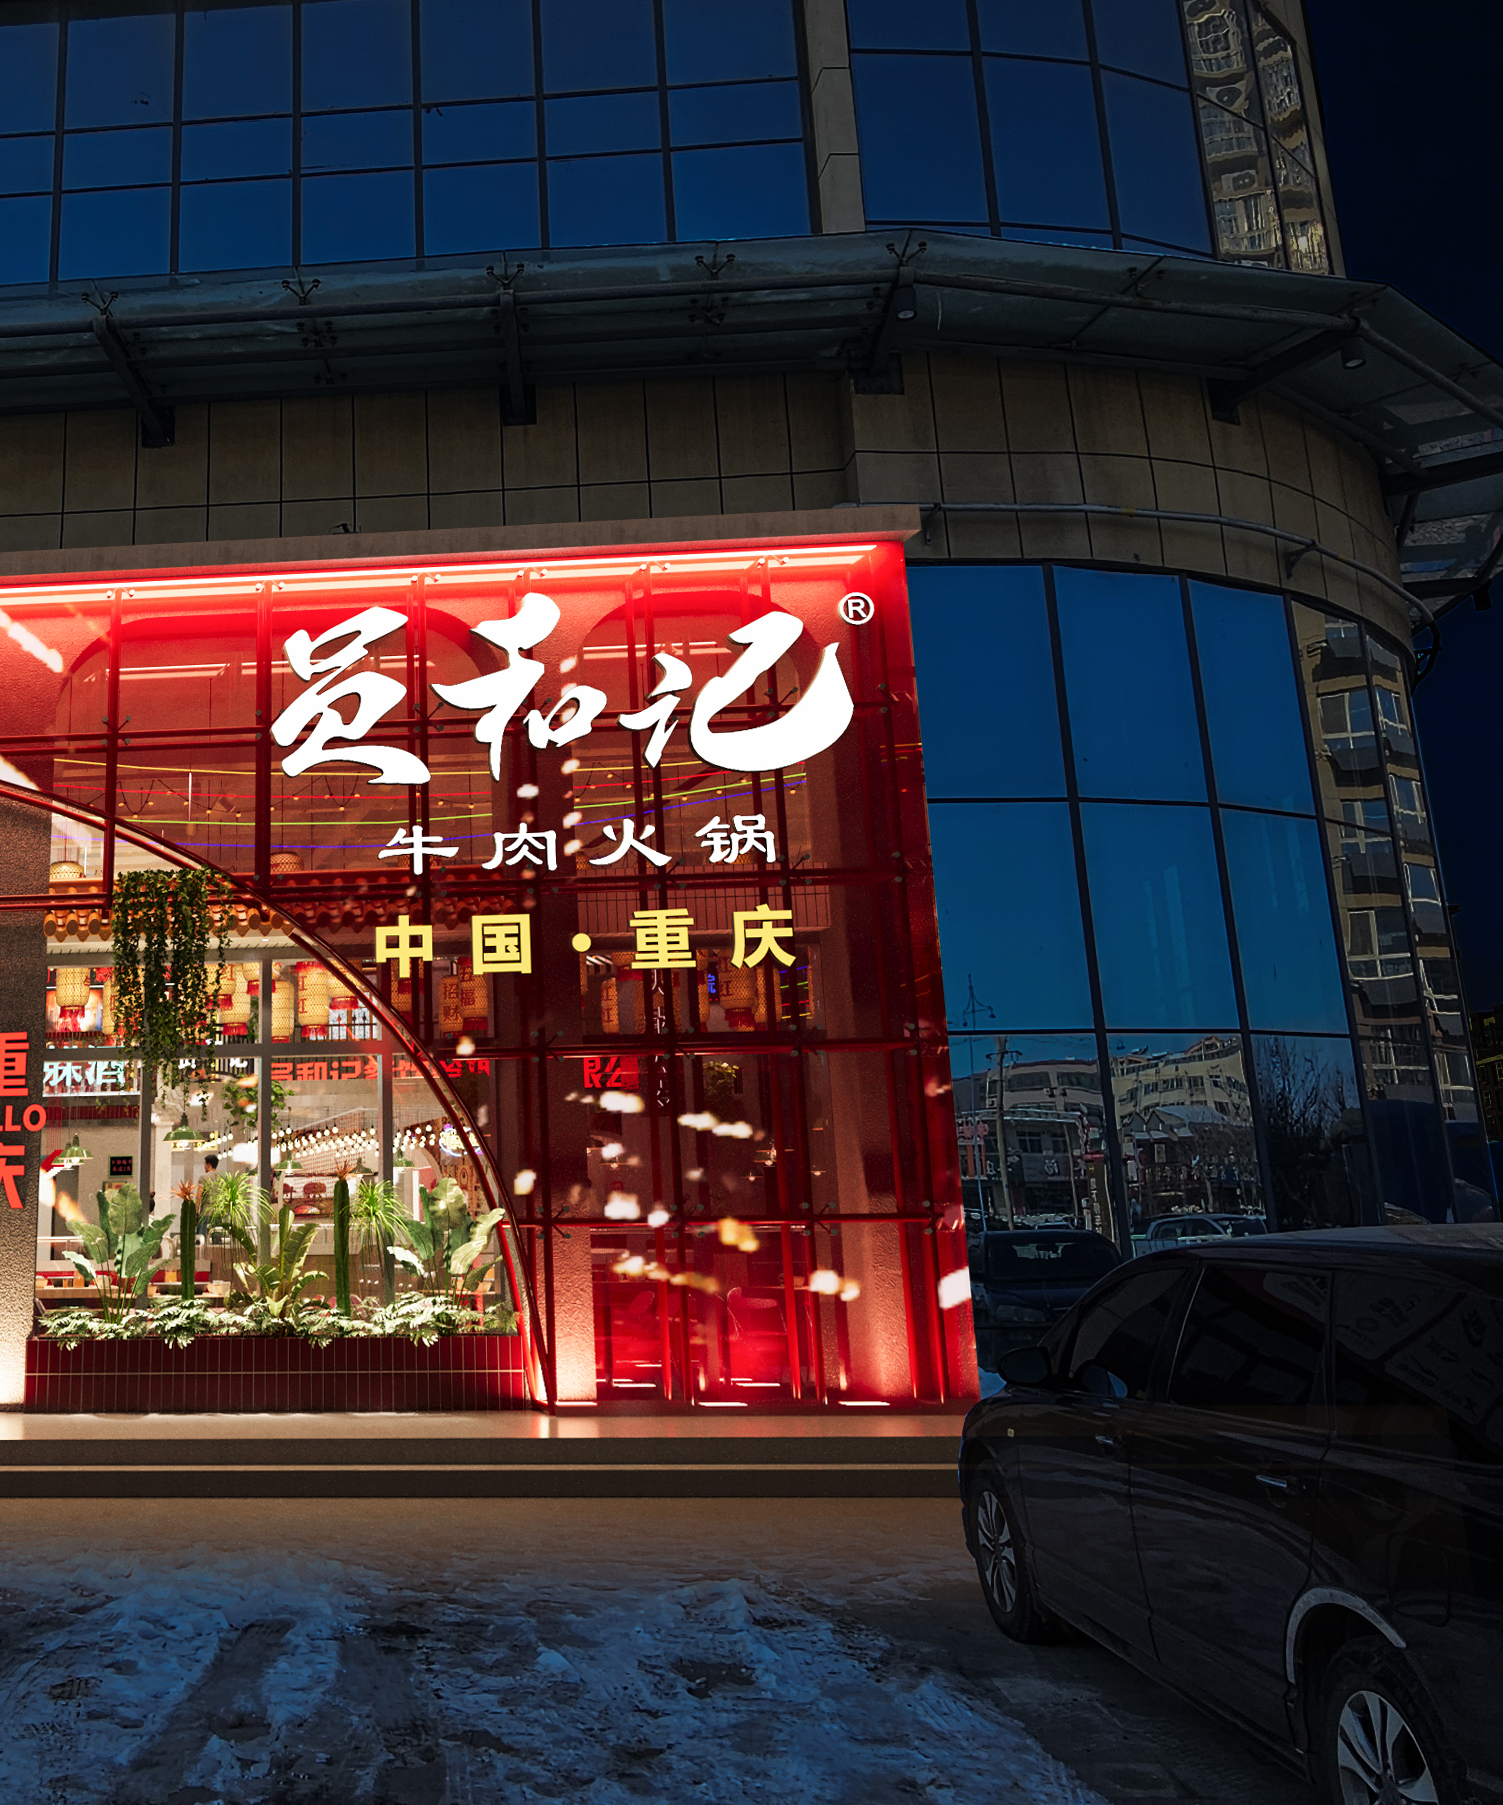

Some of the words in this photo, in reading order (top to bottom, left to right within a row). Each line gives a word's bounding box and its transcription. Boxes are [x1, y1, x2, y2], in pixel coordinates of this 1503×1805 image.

[378, 814, 777, 875] 牛肉火锅
[375, 904, 797, 979] 中国·重庆
